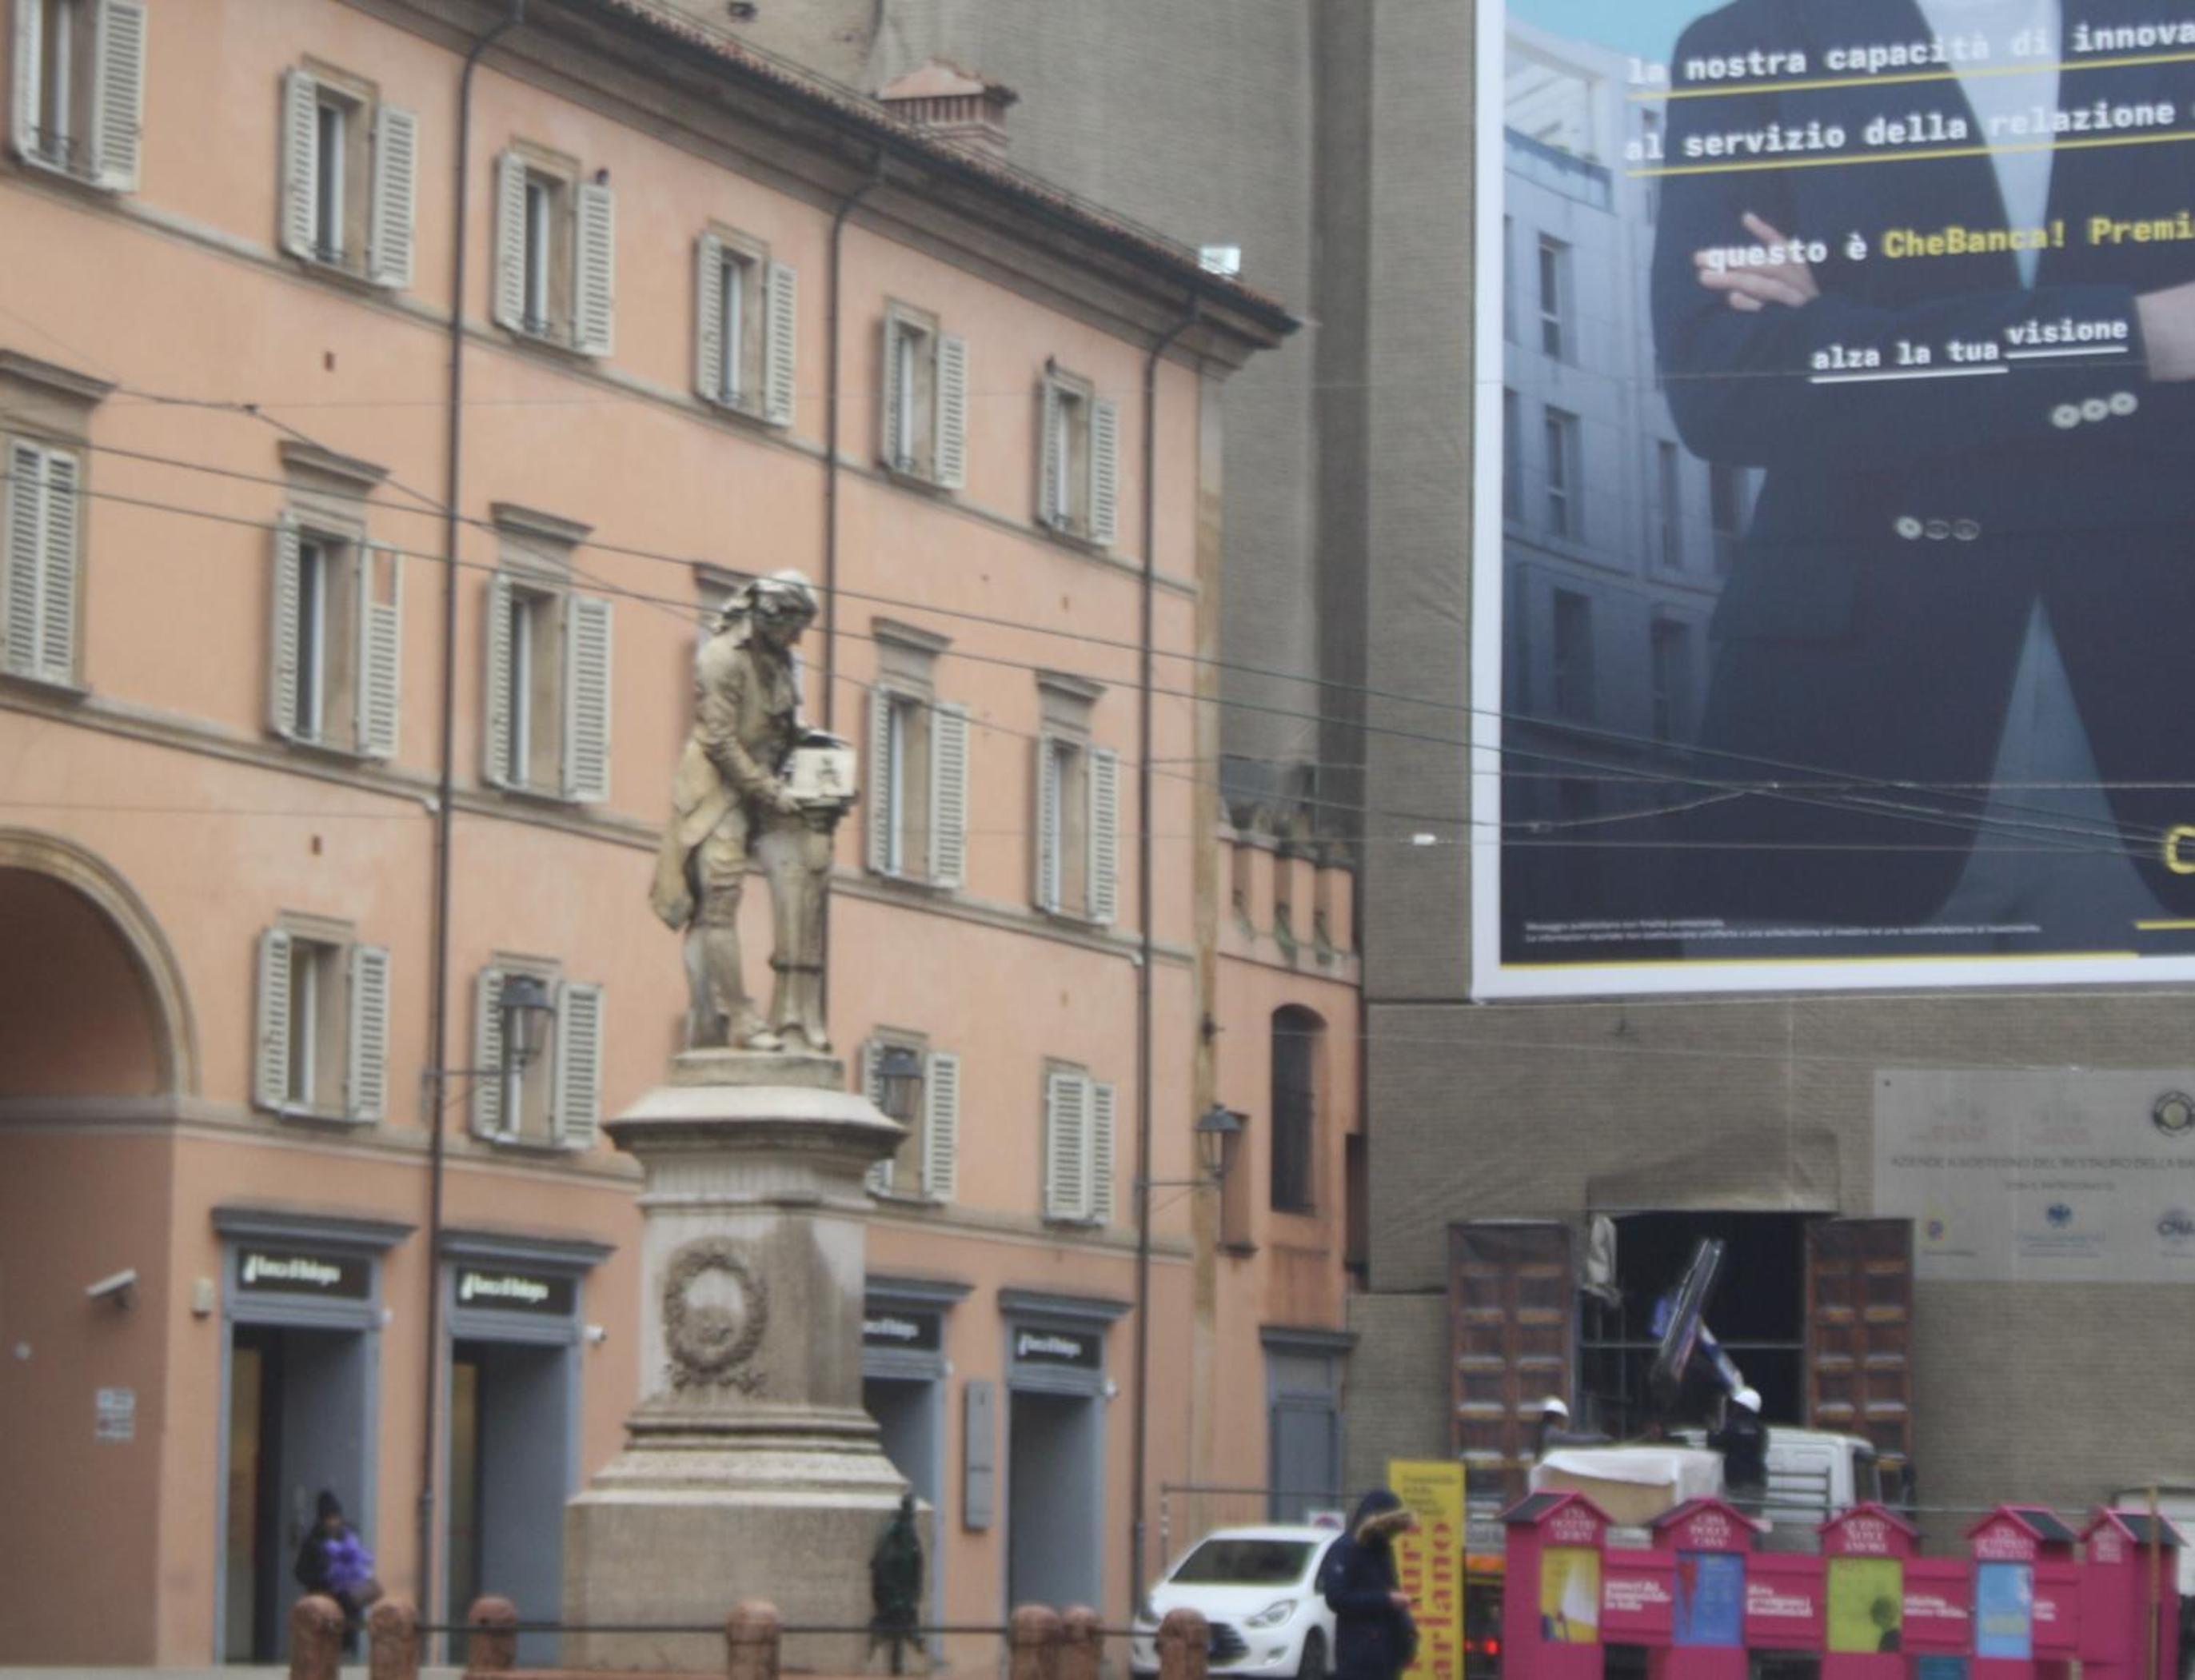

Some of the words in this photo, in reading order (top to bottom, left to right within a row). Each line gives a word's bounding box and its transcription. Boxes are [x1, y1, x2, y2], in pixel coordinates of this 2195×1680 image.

[1629, 58, 1668, 84] la
[1685, 49, 1807, 81] nostra
[1826, 36, 1991, 74] capacità
[2013, 28, 2052, 57] di
[1626, 133, 1665, 160] al
[1685, 122, 1846, 158] servizio
[1864, 110, 1968, 146] della
[1989, 100, 2176, 138] relazione
[1706, 237, 1829, 274] questo
[1846, 232, 1868, 261] è
[1883, 220, 2065, 258] CheBanca!
[2088, 211, 2195, 245] Premi
[1811, 343, 1880, 370] alza
[1896, 341, 1932, 365] la
[1946, 341, 1999, 362] tua
[2006, 317, 2129, 345] visione
